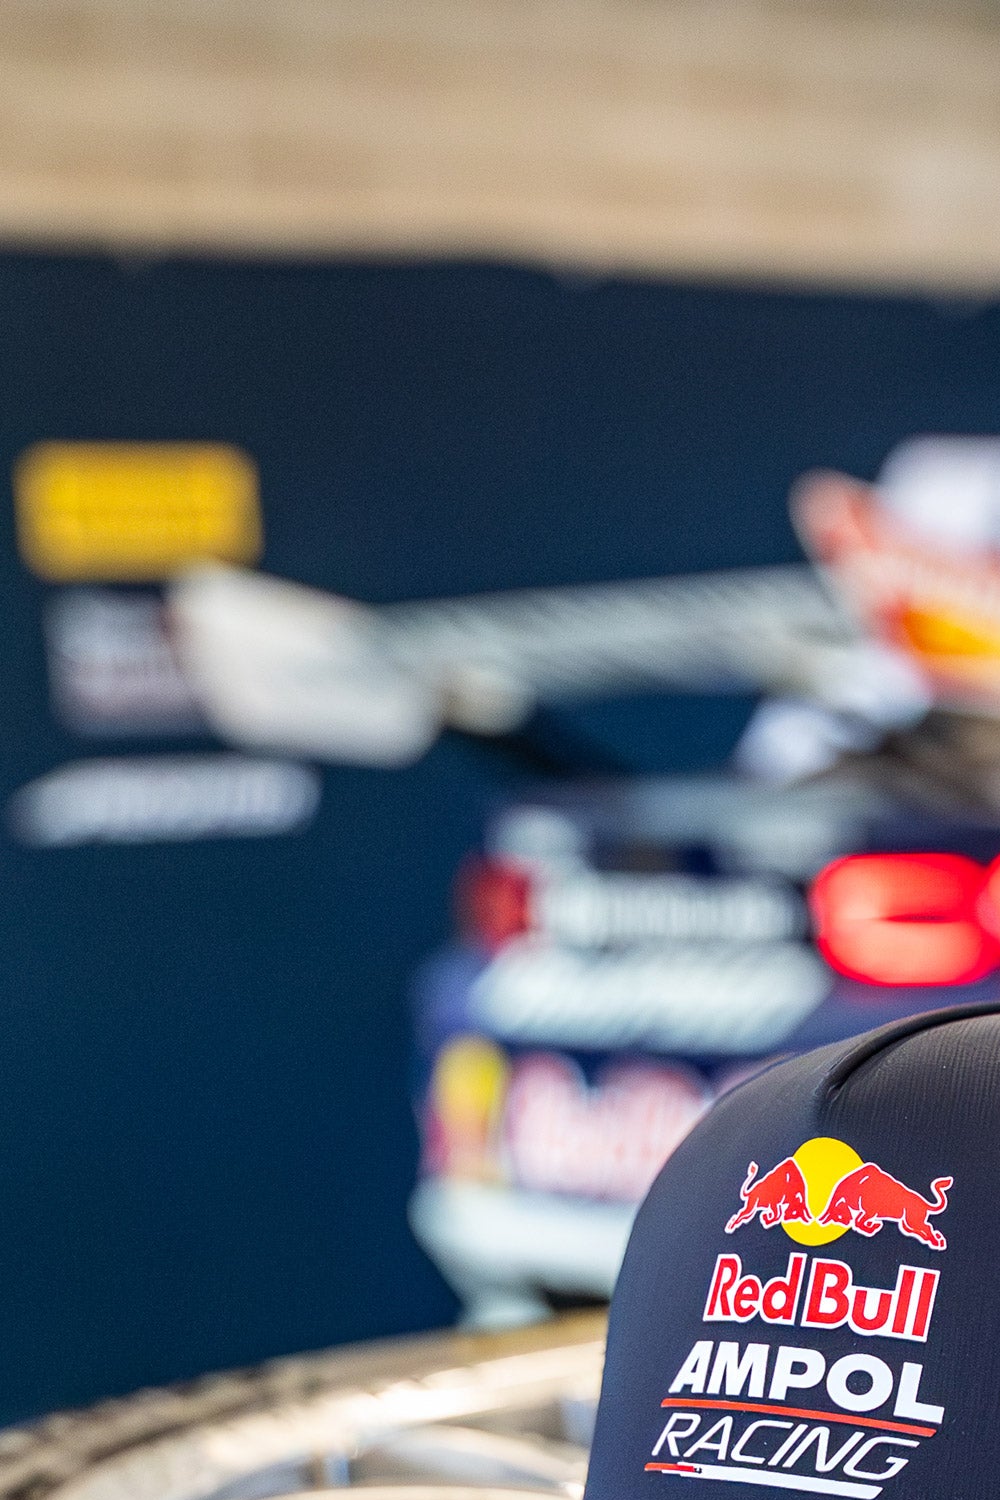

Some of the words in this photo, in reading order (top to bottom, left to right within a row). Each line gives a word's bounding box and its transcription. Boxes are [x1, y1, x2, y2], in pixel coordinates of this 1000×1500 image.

[702, 1252, 807, 1325] Red
[801, 1257, 941, 1343] Bull
[668, 1341, 945, 1425] AMPOL
[651, 1412, 920, 1481] RACING
